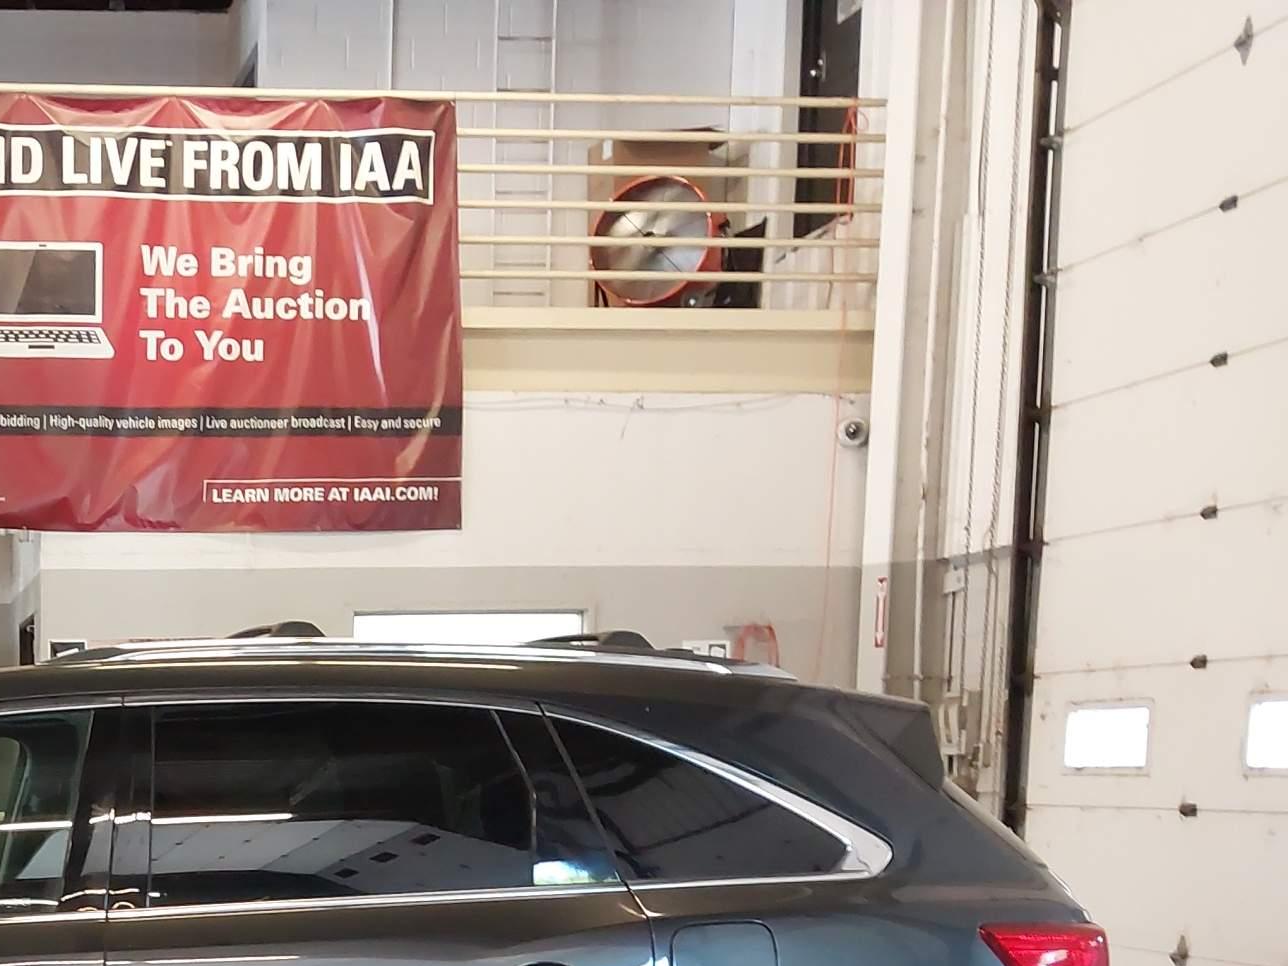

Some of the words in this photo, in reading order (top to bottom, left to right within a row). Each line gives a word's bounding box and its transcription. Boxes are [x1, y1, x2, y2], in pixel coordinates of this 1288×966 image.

[61, 136, 168, 188] LIVE
[182, 140, 322, 191] FROM
[339, 140, 424, 191] IAA
[140, 245, 199, 277] We
[210, 247, 312, 285] Bring
[139, 288, 211, 319] The
[221, 289, 371, 321] Auction
[139, 330, 185, 361] To
[194, 330, 264, 362] You
[0, 415, 41, 430] bidding
[49, 415, 114, 431] High-quality
[116, 416, 155, 429] vehicle
[157, 416, 198, 431] images
[205, 416, 228, 428] Live
[230, 415, 289, 429] auctioneer
[291, 415, 345, 428] broadcast
[354, 414, 379, 430] Easy
[381, 415, 402, 428] and
[403, 416, 441, 428] secure
[212, 488, 269, 503] LEARN
[274, 488, 324, 502] MORE
[327, 488, 349, 501] AT
[354, 486, 439, 501] IAAI.COM!
